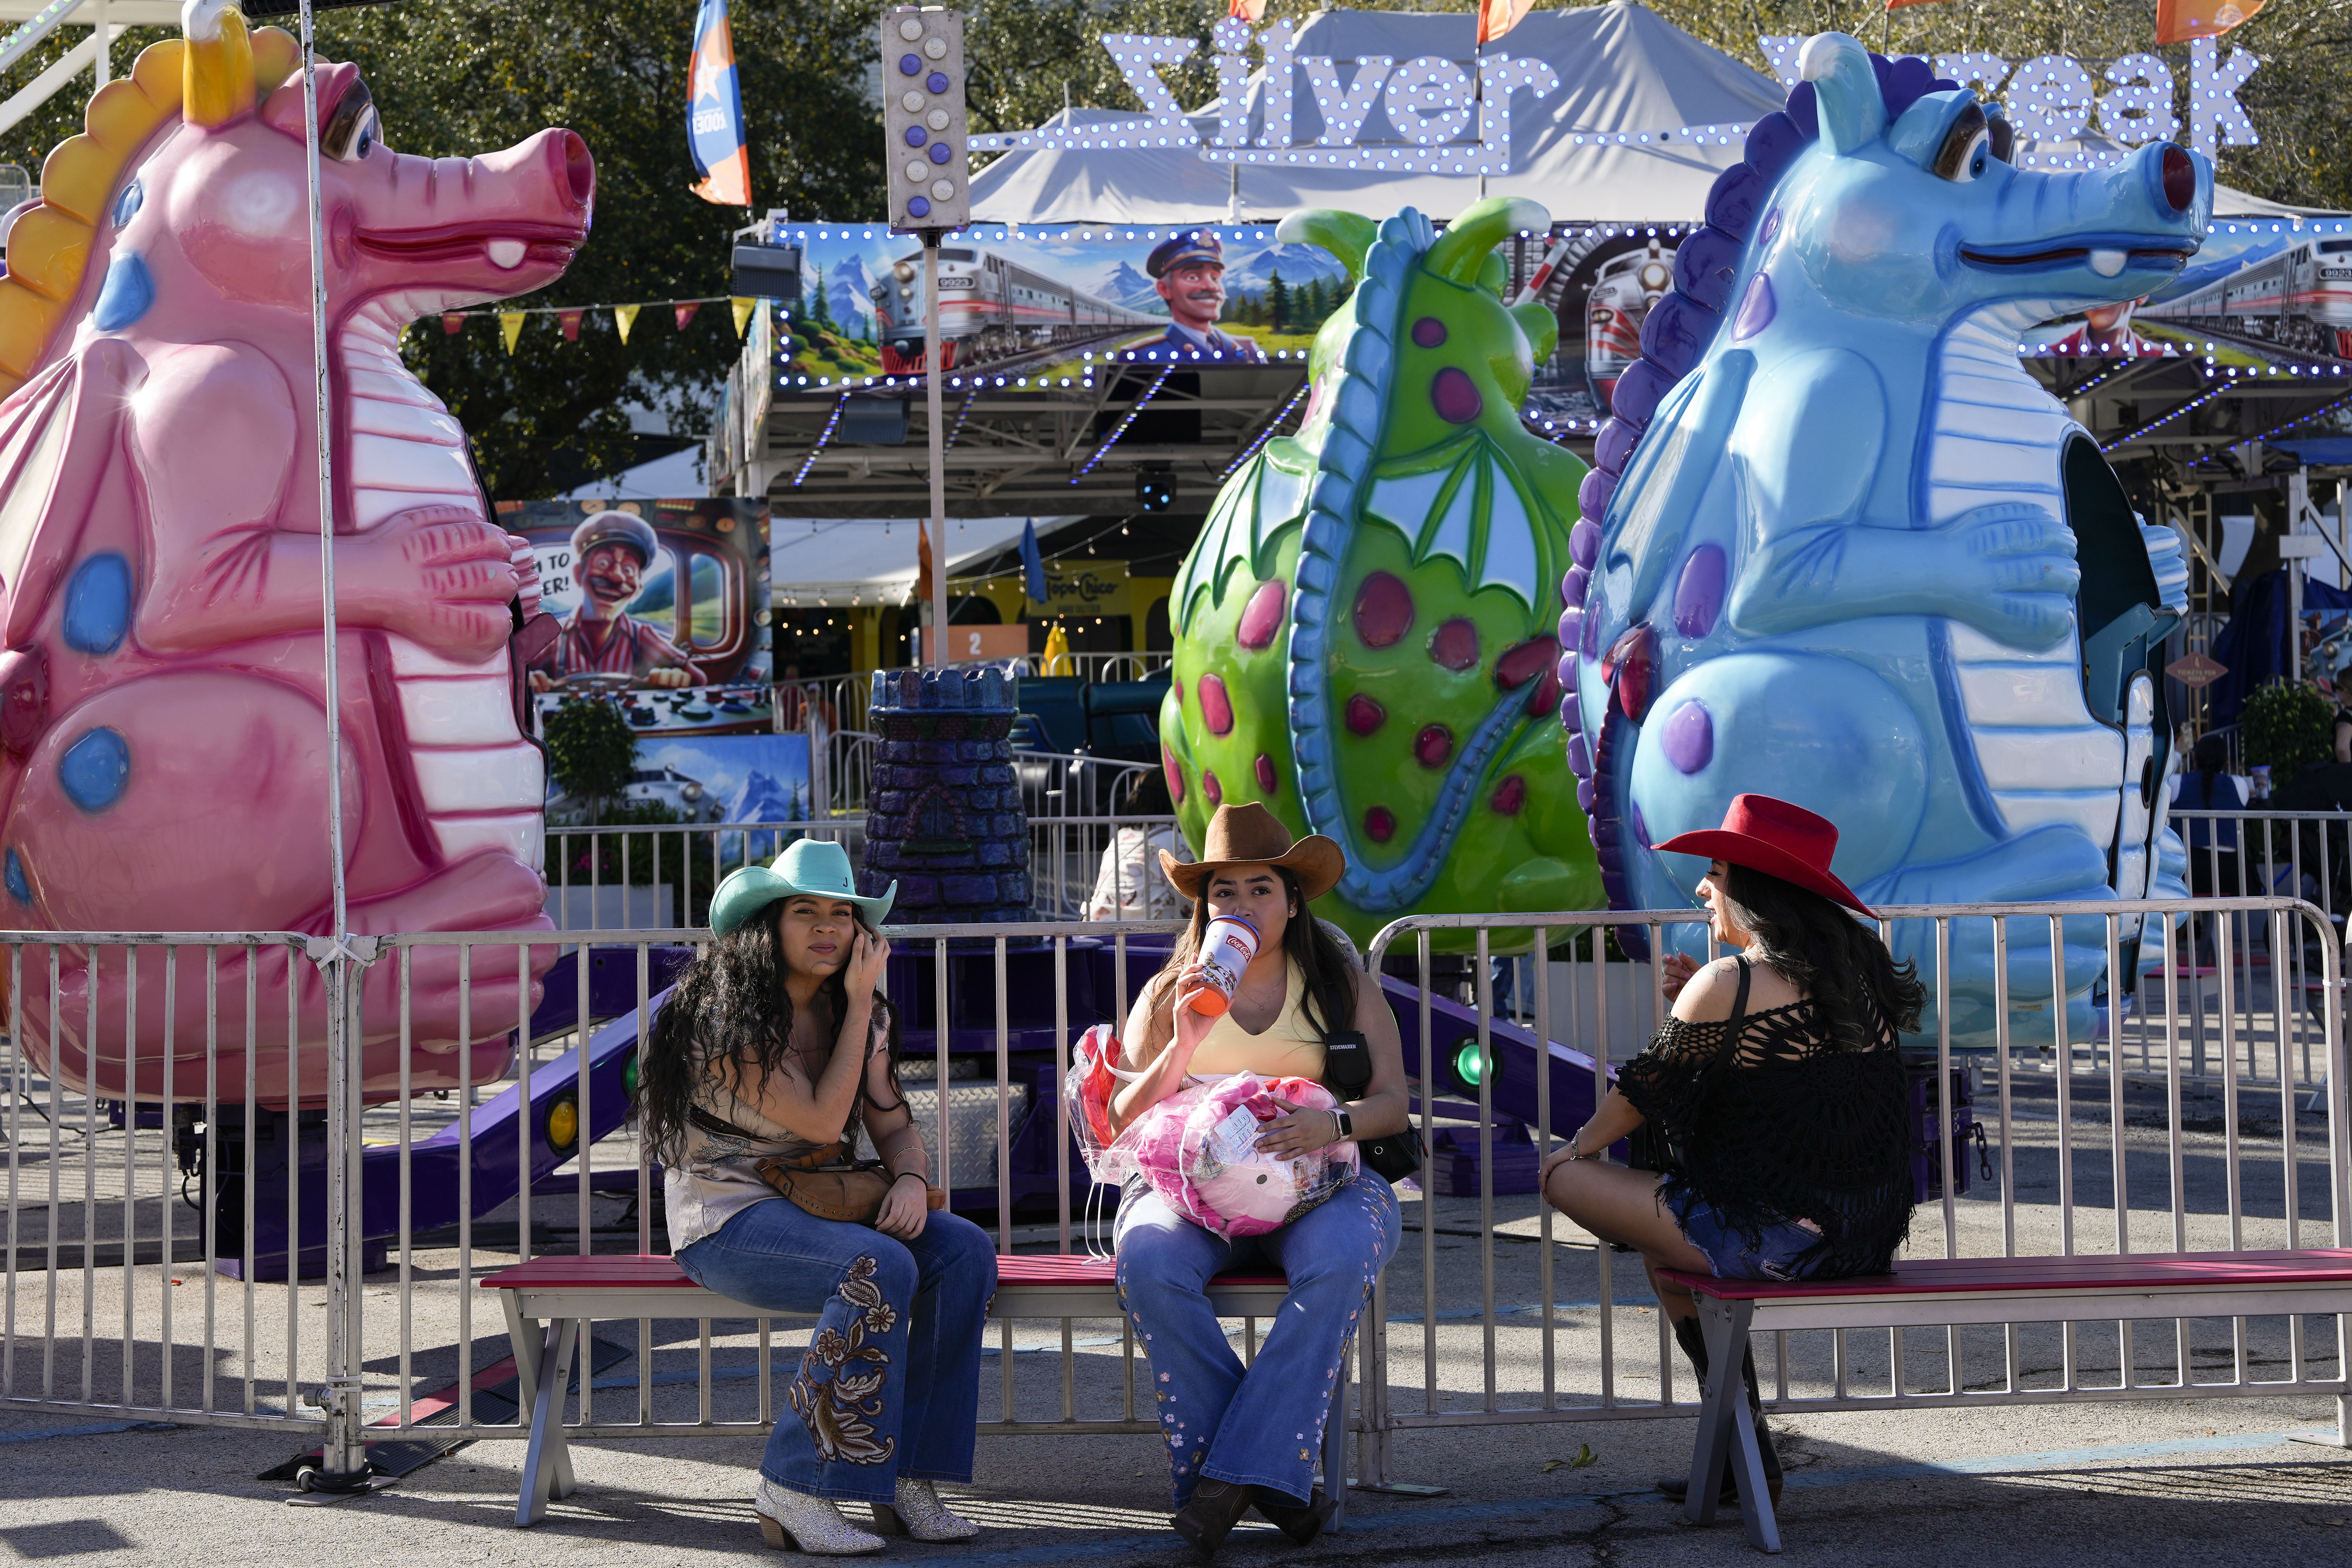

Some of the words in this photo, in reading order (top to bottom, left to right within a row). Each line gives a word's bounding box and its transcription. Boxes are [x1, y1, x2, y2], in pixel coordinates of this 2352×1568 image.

[548, 553, 570, 569] TO
[543, 576, 569, 595] ER!
[1079, 572, 1119, 602] Chico
[969, 632, 982, 655] 2
[1222, 1113, 1251, 1139] HELLO
[1230, 1122, 1255, 1148] KITTY
[1239, 1140, 1251, 1153] SEALIFE
